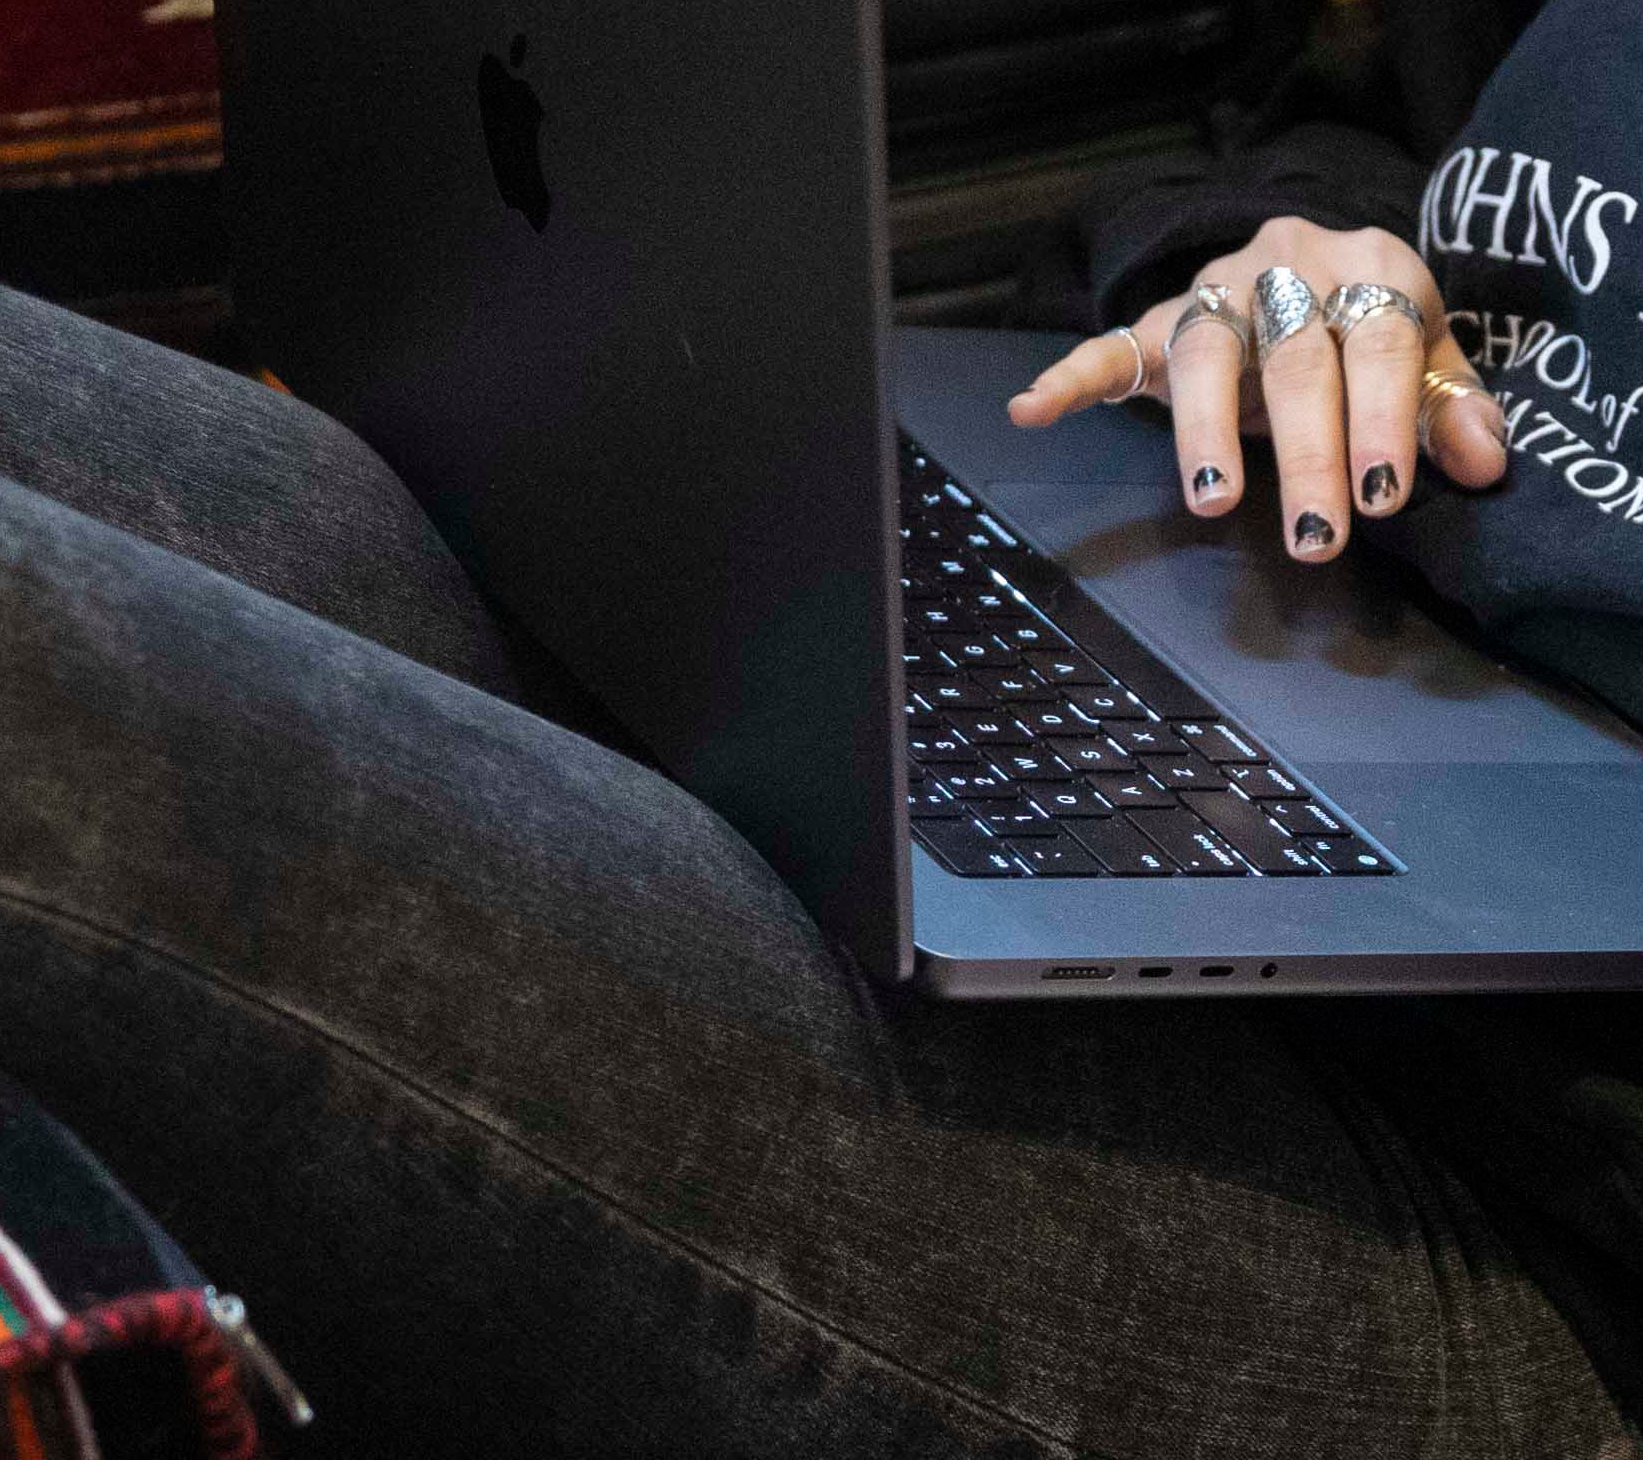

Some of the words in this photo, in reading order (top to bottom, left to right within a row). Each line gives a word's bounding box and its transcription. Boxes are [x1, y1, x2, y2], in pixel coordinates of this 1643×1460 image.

[1446, 310, 1597, 413] CHOOL
[1053, 662, 1076, 674] V
[939, 687, 961, 697] R
[1093, 697, 1115, 707] C
[976, 722, 1000, 733] E
[1131, 732, 1156, 742] X
[1079, 749, 1102, 760] S
[1013, 757, 1039, 769] W
[1171, 767, 1196, 778] Z
[1120, 786, 1143, 796] A
[1055, 794, 1078, 805] Q
[1303, 804, 1341, 830] control
